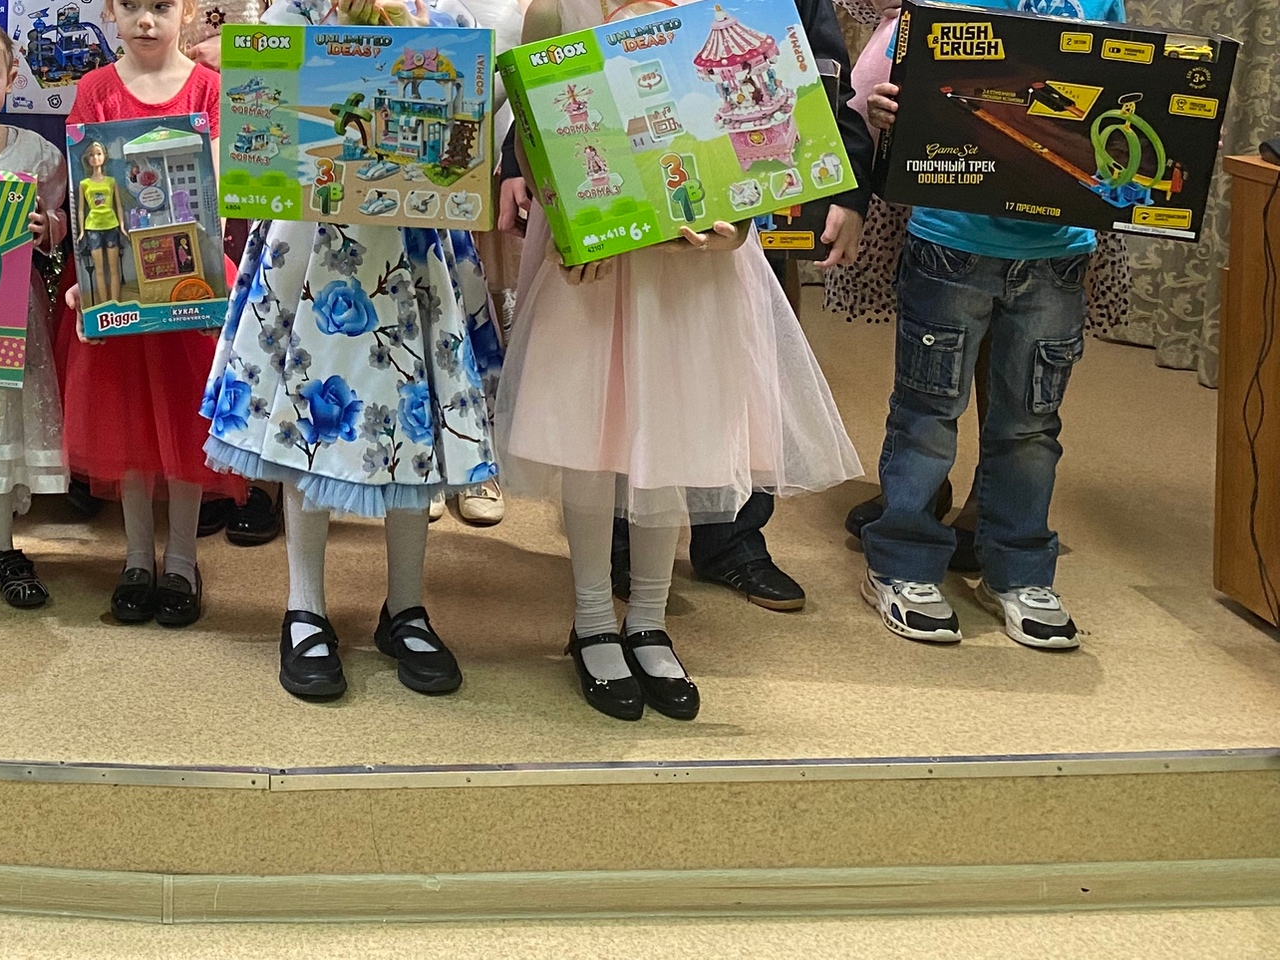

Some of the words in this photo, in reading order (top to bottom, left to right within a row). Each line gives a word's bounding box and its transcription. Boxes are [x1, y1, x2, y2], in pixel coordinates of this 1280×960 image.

[606, 18, 682, 46] UNLIMITED
[940, 25, 989, 41] RUSH
[314, 33, 393, 47] UNLIMITED
[940, 41, 999, 56] CRUSH
[1192, 72, 1206, 84] 3+
[556, 123, 590, 136] ФОРМА
[926, 143, 960, 159] Game
[906, 158, 966, 172] ГОНОЧНЫЙ
[968, 160, 996, 173] ТРЕК
[918, 173, 956, 184] DOUBLE
[958, 174, 984, 185] LOOP
[8, 193, 23, 202] 3+
[576, 186, 611, 200] ФОРМА
[271, 195, 294, 213] 6+
[1005, 201, 1015, 211] 17
[1015, 203, 1061, 217] ПРЕДМЕТОВ
[629, 222, 651, 241] 6+
[172, 307, 200, 316] КУКЛА
[98, 311, 138, 330] Bigga
